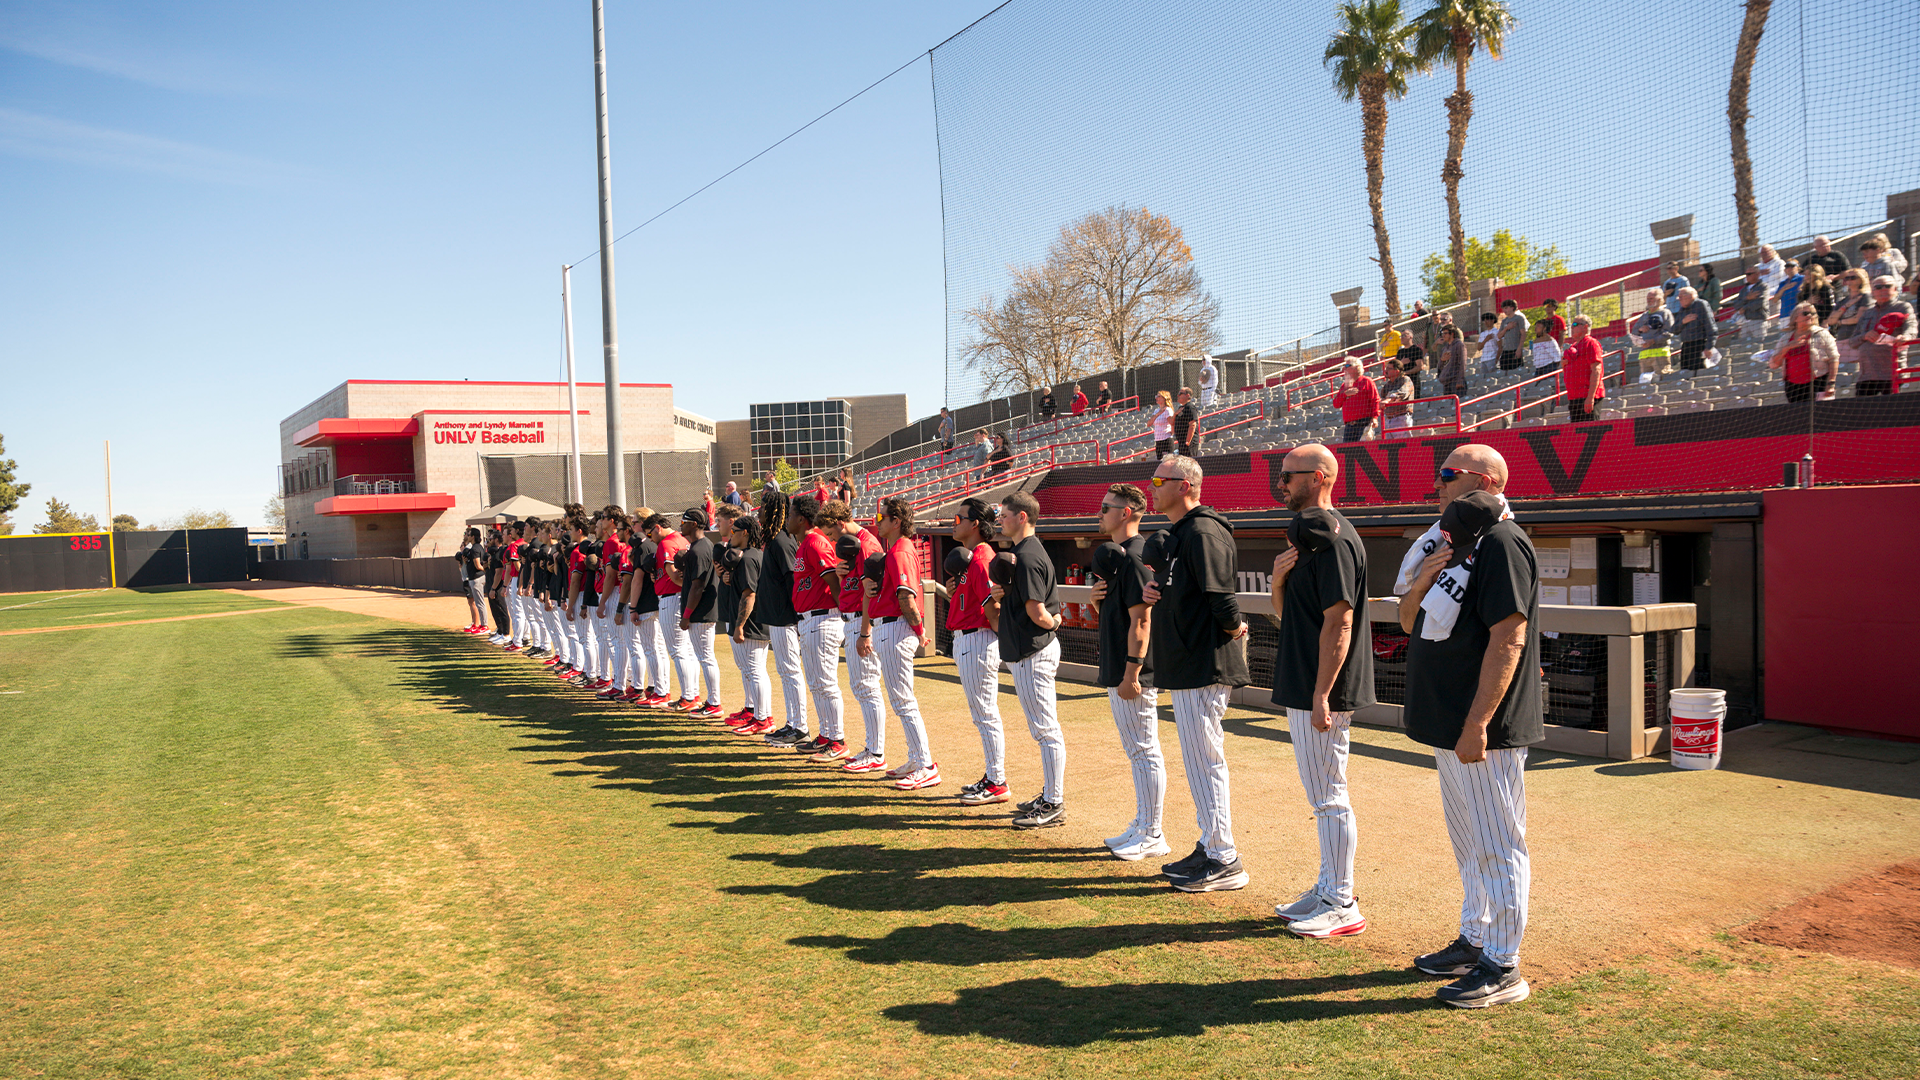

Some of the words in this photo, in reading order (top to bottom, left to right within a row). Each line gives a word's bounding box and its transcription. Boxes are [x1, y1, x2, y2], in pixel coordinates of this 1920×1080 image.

[434, 421, 466, 430] Anthony
[484, 421, 507, 430] Lyndy
[679, 416, 696, 430] ATHLETIC
[697, 422, 714, 435] COMPLEX
[434, 431, 476, 444] UNLV
[481, 430, 544, 443] Baseball
[70, 536, 102, 550] 335
[843, 577, 859, 591] 32
[959, 593, 965, 611] 1
[1674, 726, 1716, 742] Rawlings
